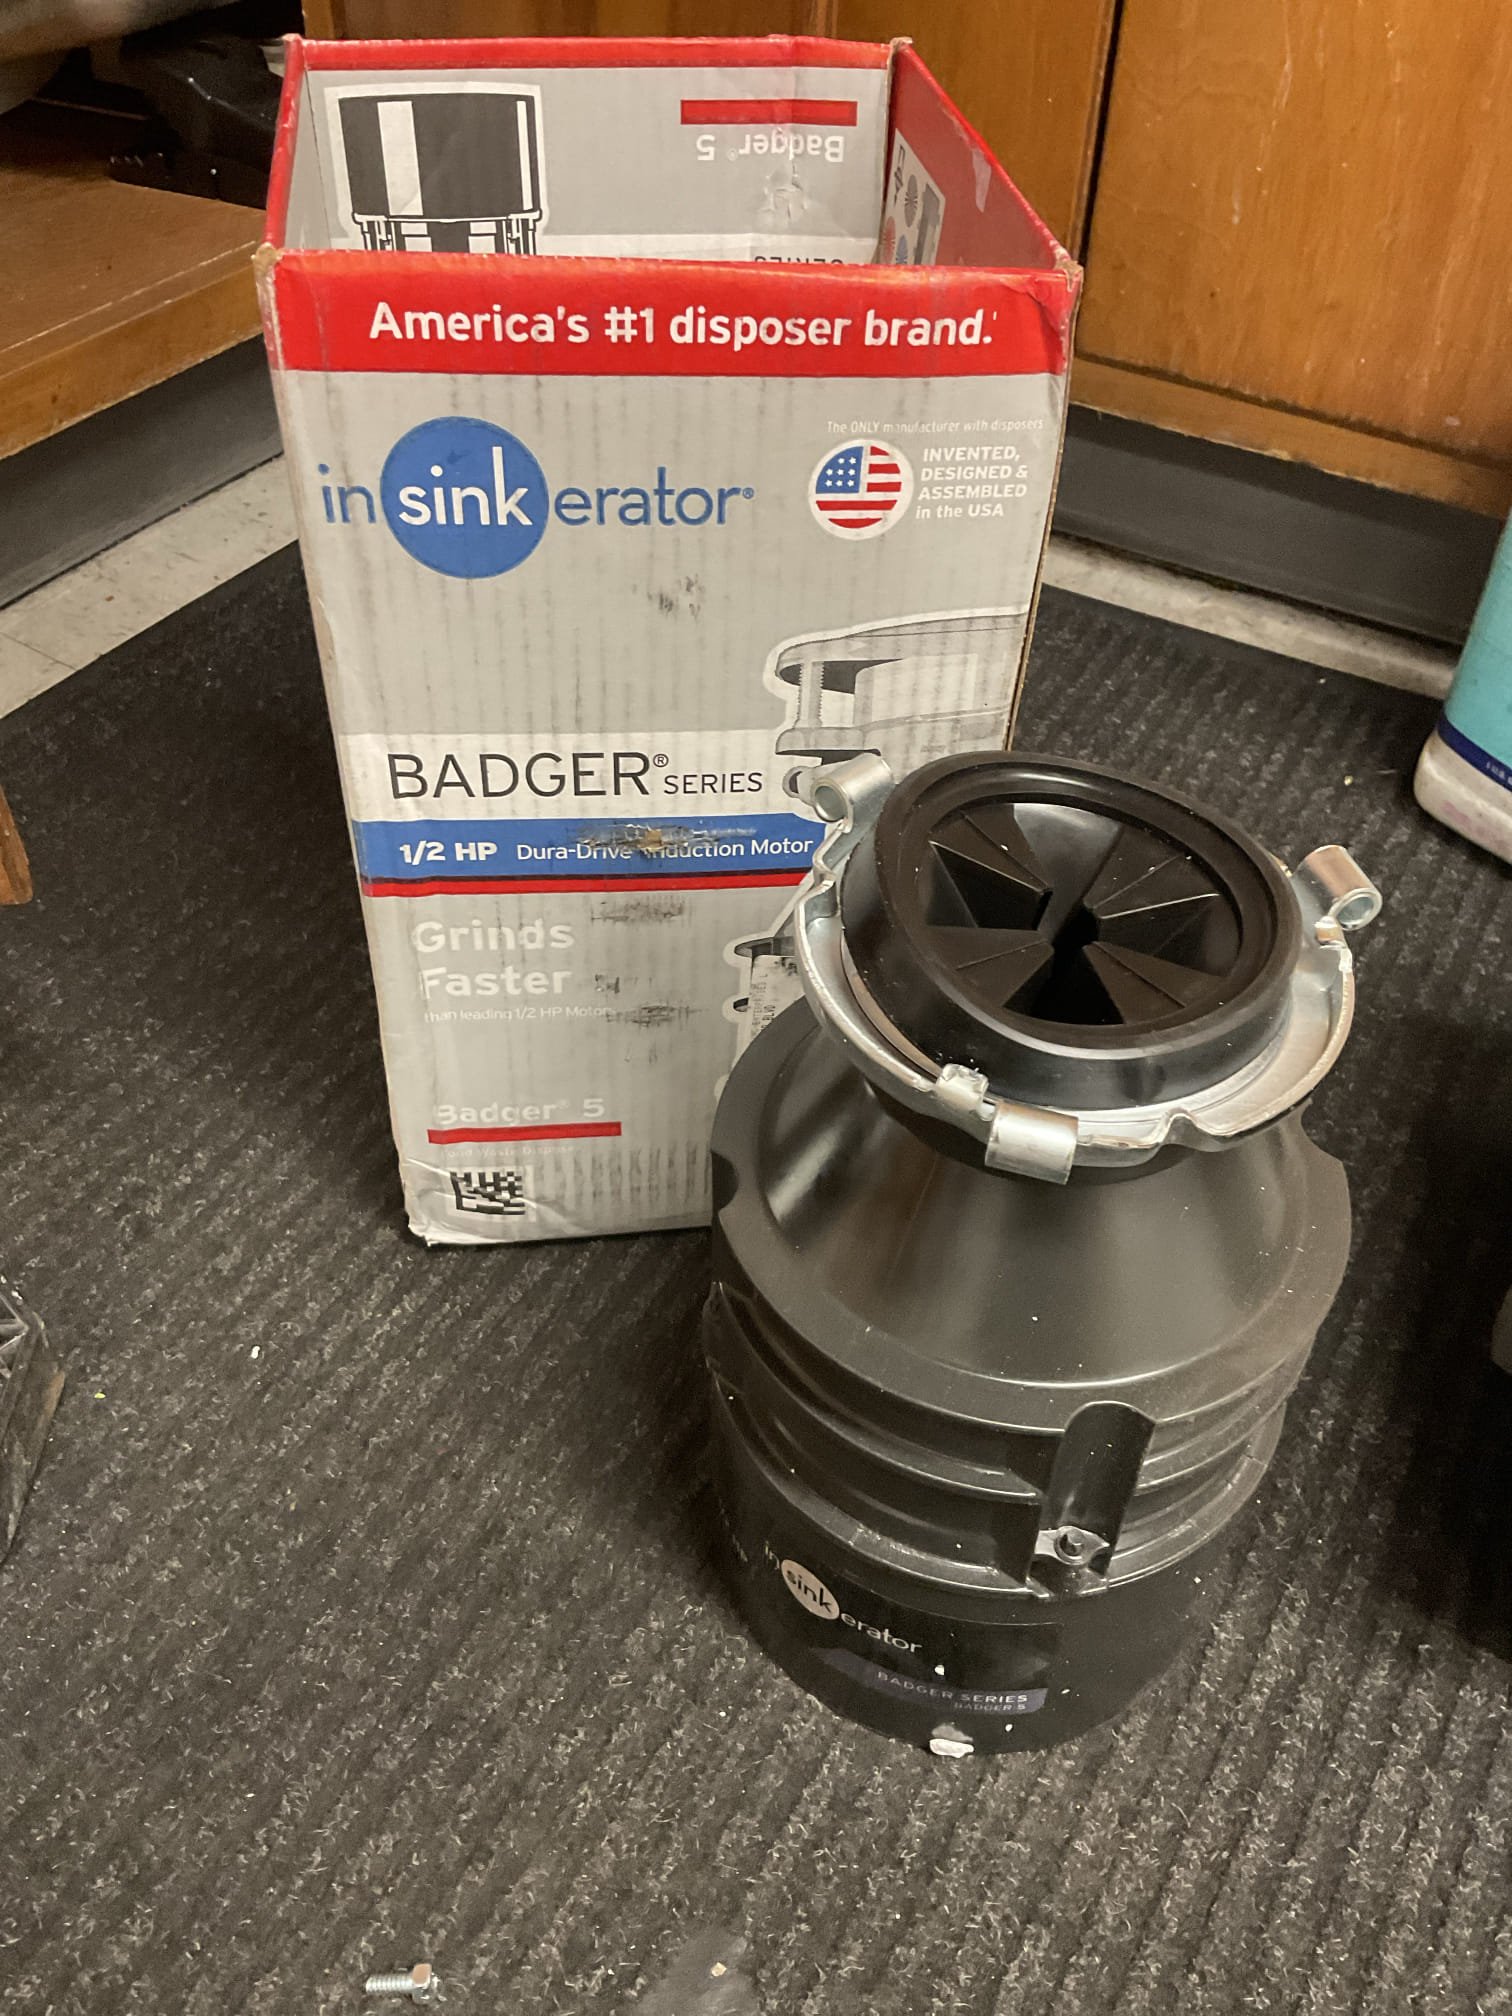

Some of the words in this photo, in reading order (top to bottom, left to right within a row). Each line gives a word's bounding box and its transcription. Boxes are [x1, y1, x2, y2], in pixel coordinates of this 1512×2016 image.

[696, 134, 716, 161] 5
[369, 301, 590, 343] America's
[604, 306, 654, 343] #1
[669, 305, 852, 352] disposer
[850, 421, 879, 433] ONLY
[963, 420, 988, 433] with
[991, 418, 1044, 433] disposers
[922, 446, 1021, 463] INVENTED,
[920, 466, 1011, 481] DESIGNED
[1016, 465, 1029, 479] &
[918, 484, 1027, 500] ASSEMBLED
[915, 506, 932, 519] in
[936, 505, 963, 518] the
[967, 504, 1005, 517] USA
[663, 772, 763, 795] SERIES
[399, 840, 446, 866] 1/2
[455, 842, 498, 861] HP
[516, 842, 633, 860] Dura-Drive
[750, 837, 814, 856] Motor
[412, 918, 575, 953] Grinds
[419, 965, 573, 999] Faster
[424, 1009, 457, 1023] than
[460, 1007, 512, 1021] leading
[515, 1007, 537, 1019] 1/2
[540, 1006, 563, 1018] HP
[583, 1098, 606, 1118] 5
[877, 1671, 953, 1699] BADGER
[960, 1694, 1028, 1703] SERIES
